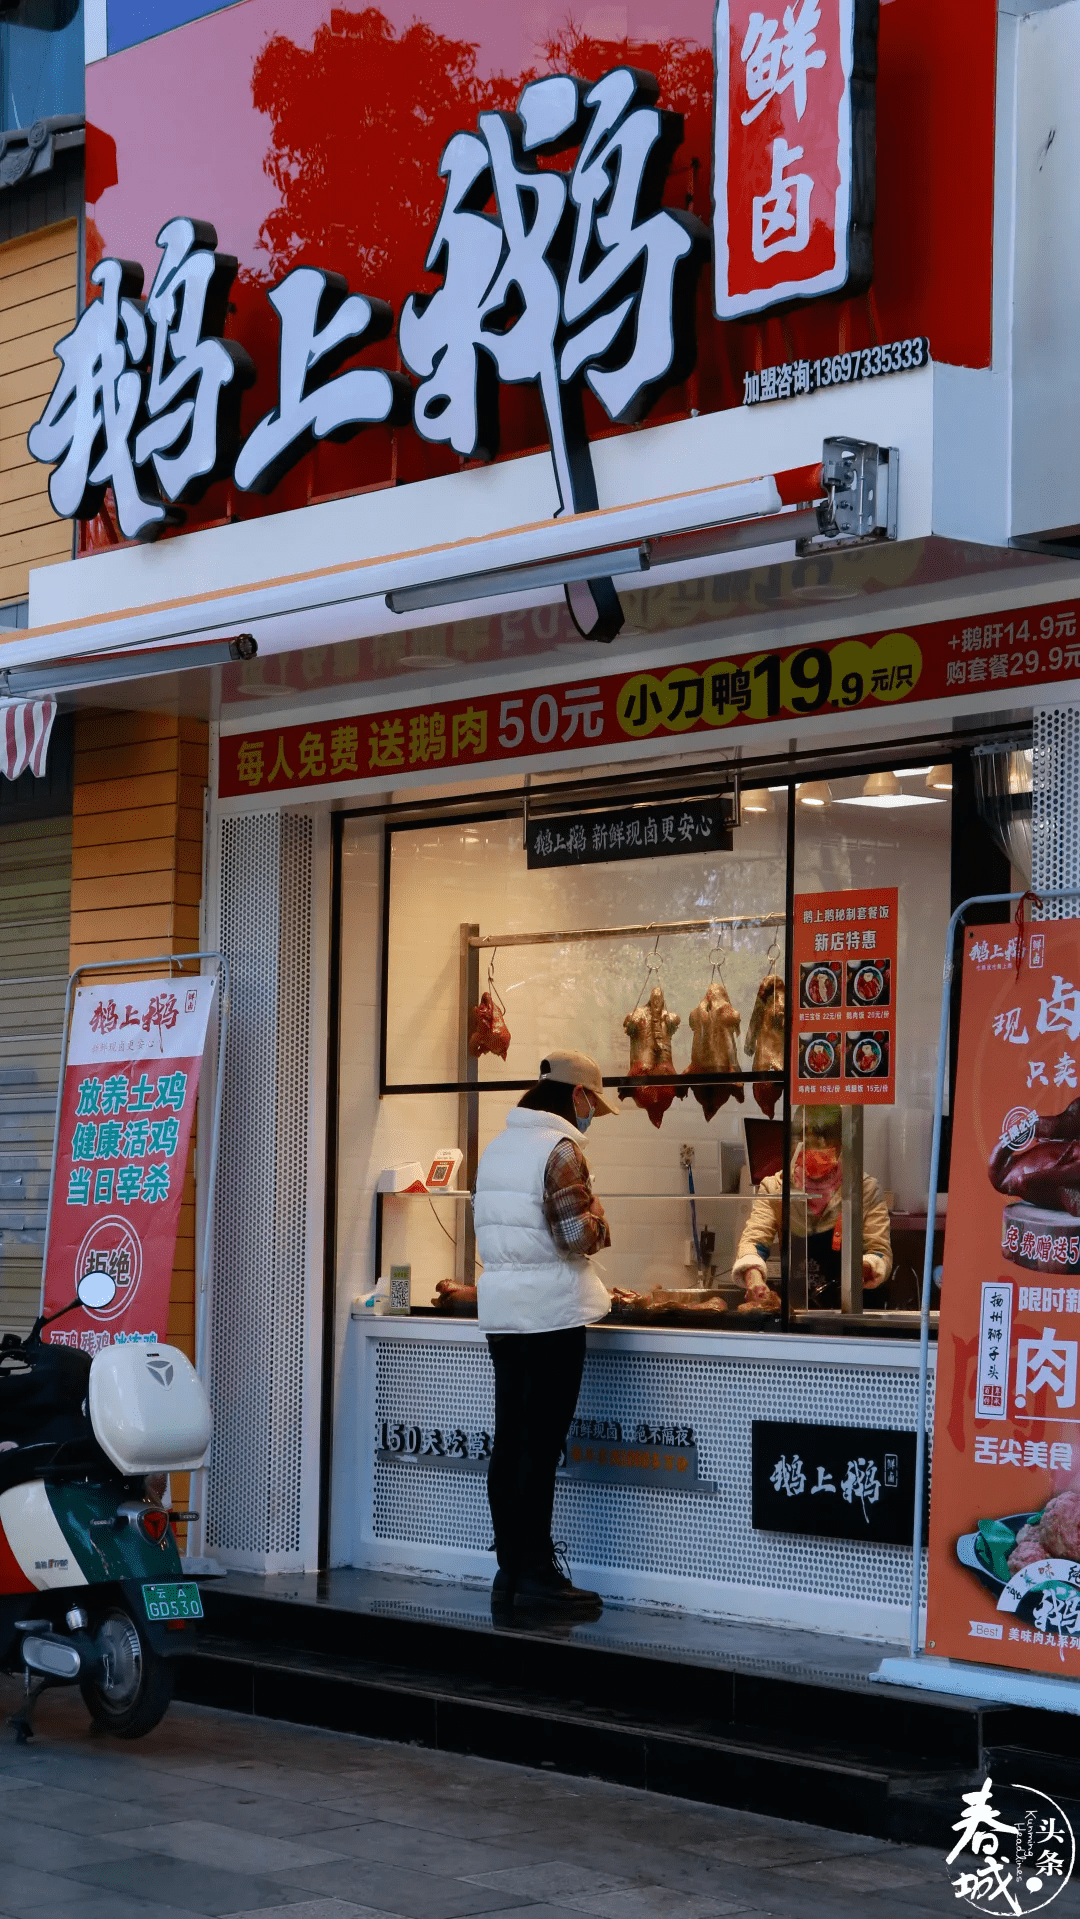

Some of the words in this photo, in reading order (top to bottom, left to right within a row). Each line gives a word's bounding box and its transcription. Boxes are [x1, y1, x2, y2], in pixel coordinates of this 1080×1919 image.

[741, 0, 827, 263] 鲜卤
[28, 68, 694, 542] 鹅上鹅
[743, 336, 923, 404] 加盟咨询:13697335333
[948, 611, 1077, 653] +鹅肝14.9元
[946, 643, 1080, 687] 购套餐29.9元
[592, 813, 713, 851] 新鲜现卤更安心
[803, 905, 890, 924] 鹅上鹅秘制套餐饭
[815, 930, 877, 952] 新店特惠
[89, 993, 180, 1053] 鹅上鹅
[75, 1070, 188, 1117] 放养土鸡
[71, 1117, 181, 1162] 健康活鸡
[66, 1163, 171, 1206] 当日宰杀
[986, 1291, 1005, 1380] 扬州狮子头
[636, 1425, 691, 1447] 绝不隔夜
[974, 1436, 1073, 1471] 舌尖美食
[769, 1454, 882, 1524] 鹅上鹅
[149, 1600, 200, 1617] GD530
[177, 1588, 187, 1599] A
[976, 1624, 999, 1637] Best
[1008, 1627, 1080, 1650] 美味肉丸系列
